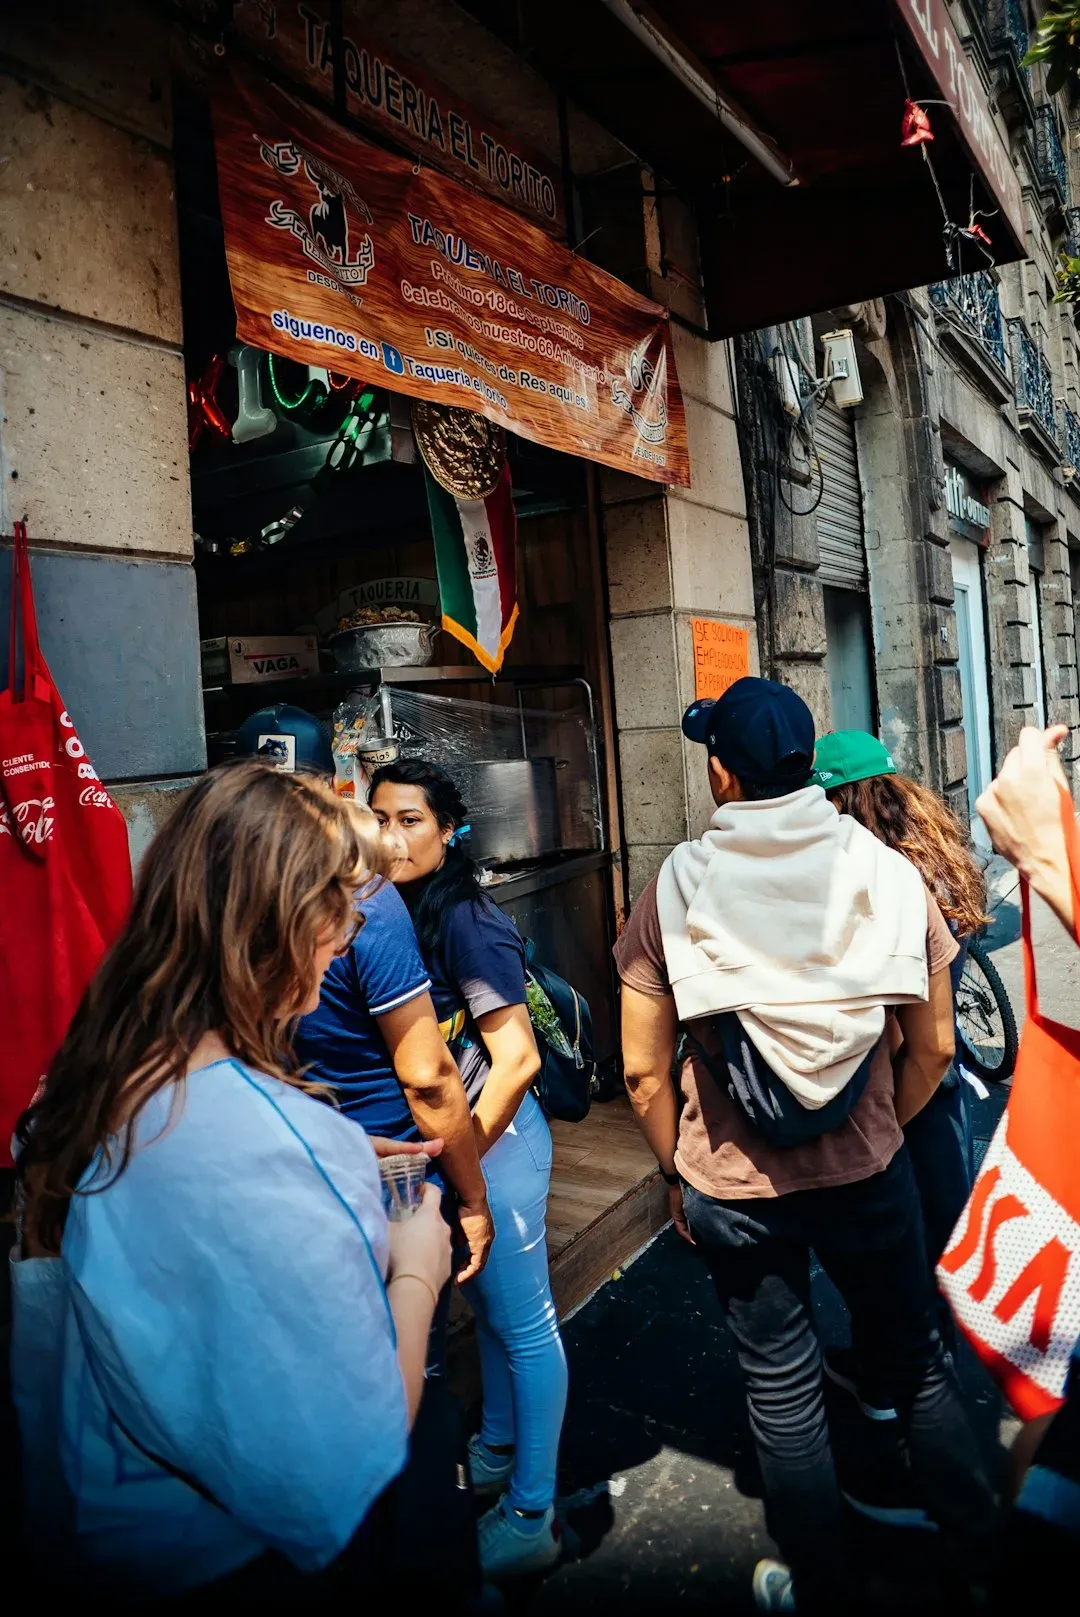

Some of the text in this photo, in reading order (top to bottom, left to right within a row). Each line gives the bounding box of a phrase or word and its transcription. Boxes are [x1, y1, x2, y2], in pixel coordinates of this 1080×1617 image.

[448, 110, 479, 171] EL
[481, 132, 556, 220] TORITO
[408, 213, 590, 325] TAQUERIA EL TORITO
[271, 309, 356, 352] siguenos
[358, 338, 380, 361] en
[404, 358, 470, 391] Taqueria
[401, 280, 606, 384] Celebramos nuestro 66 Aniversario
[486, 290, 507, 314] 18
[506, 300, 525, 320] de
[525, 308, 584, 350] Septiembre
[456, 340, 497, 376] quieres
[498, 364, 517, 385] de
[519, 371, 547, 393] Res
[695, 620, 709, 641] SE
[253, 656, 300, 674] VAGA
[2, 753, 34, 767] CLIENTE
